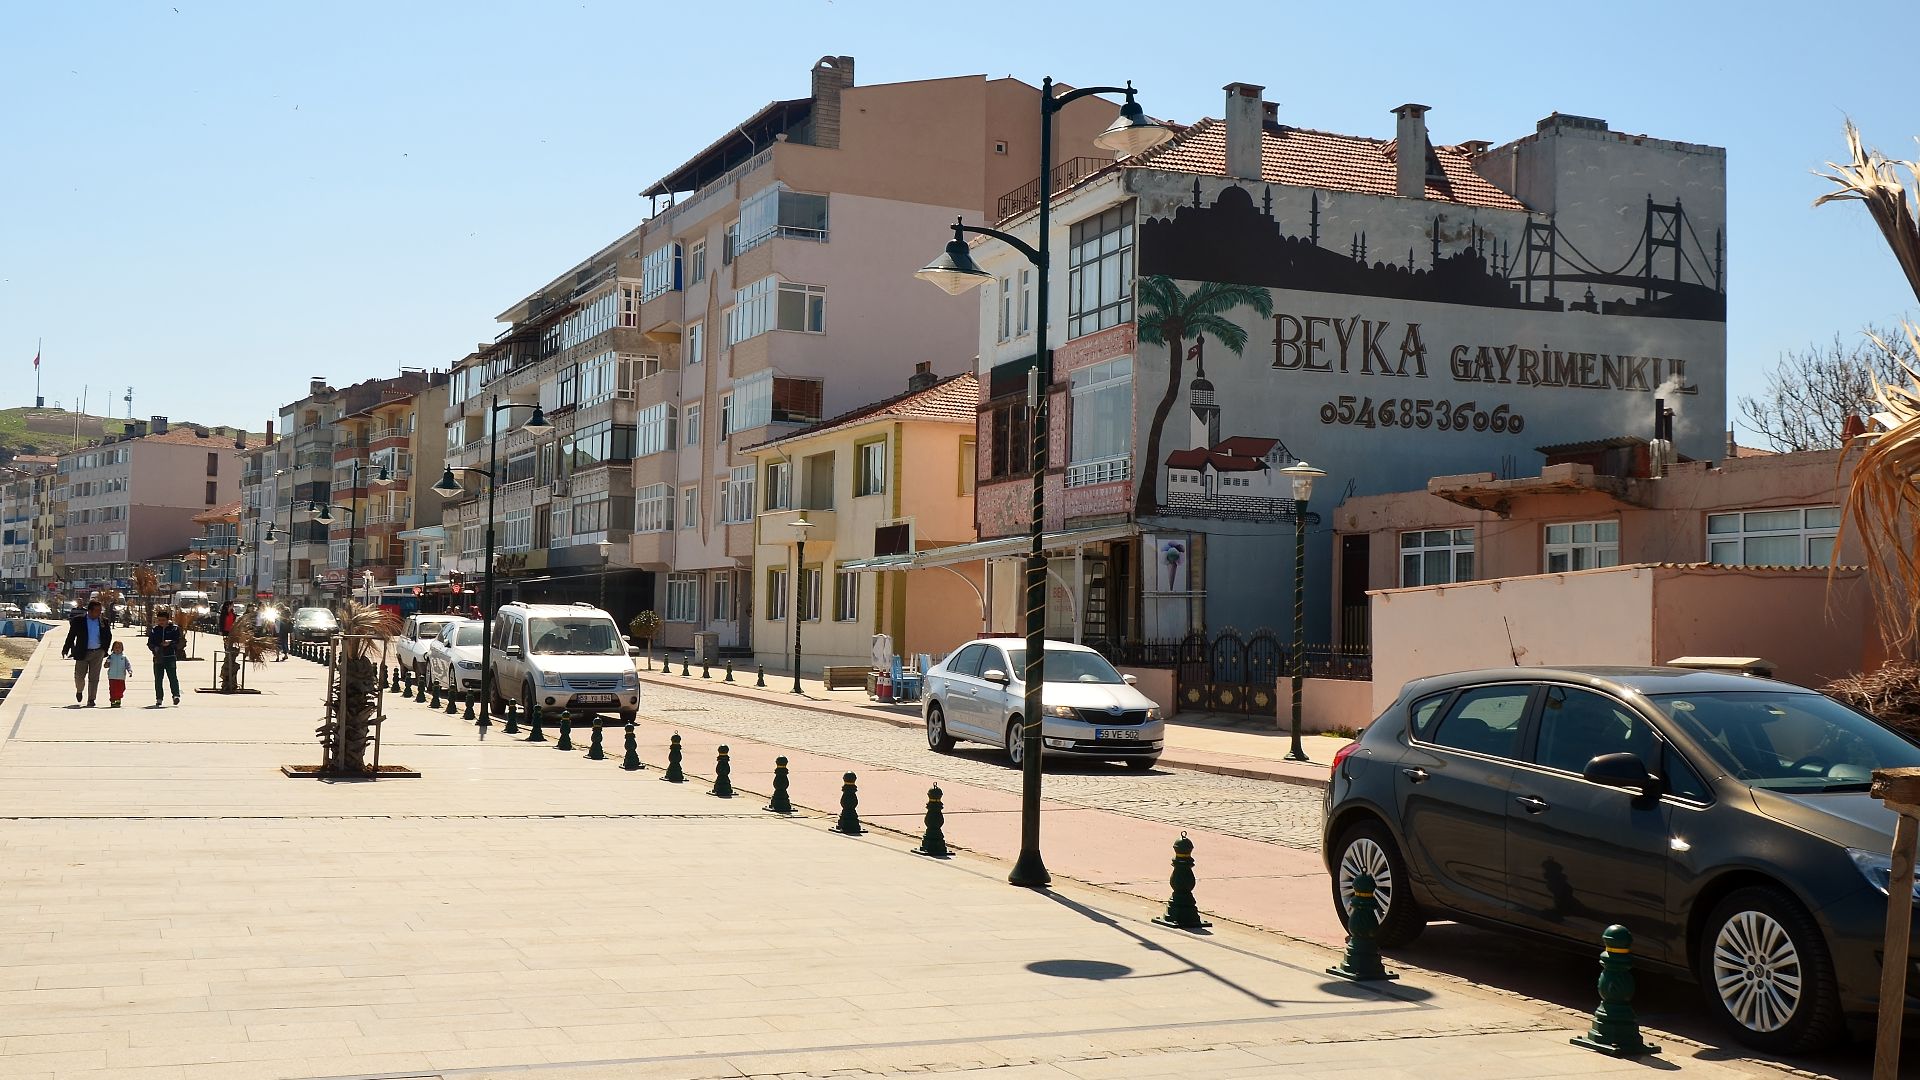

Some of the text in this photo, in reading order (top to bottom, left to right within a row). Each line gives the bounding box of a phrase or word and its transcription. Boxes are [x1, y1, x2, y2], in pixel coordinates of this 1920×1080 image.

[1271, 313, 1699, 395] BEYKA GAYRİMENKUL
[1100, 730, 1139, 739] 59 VE 502
